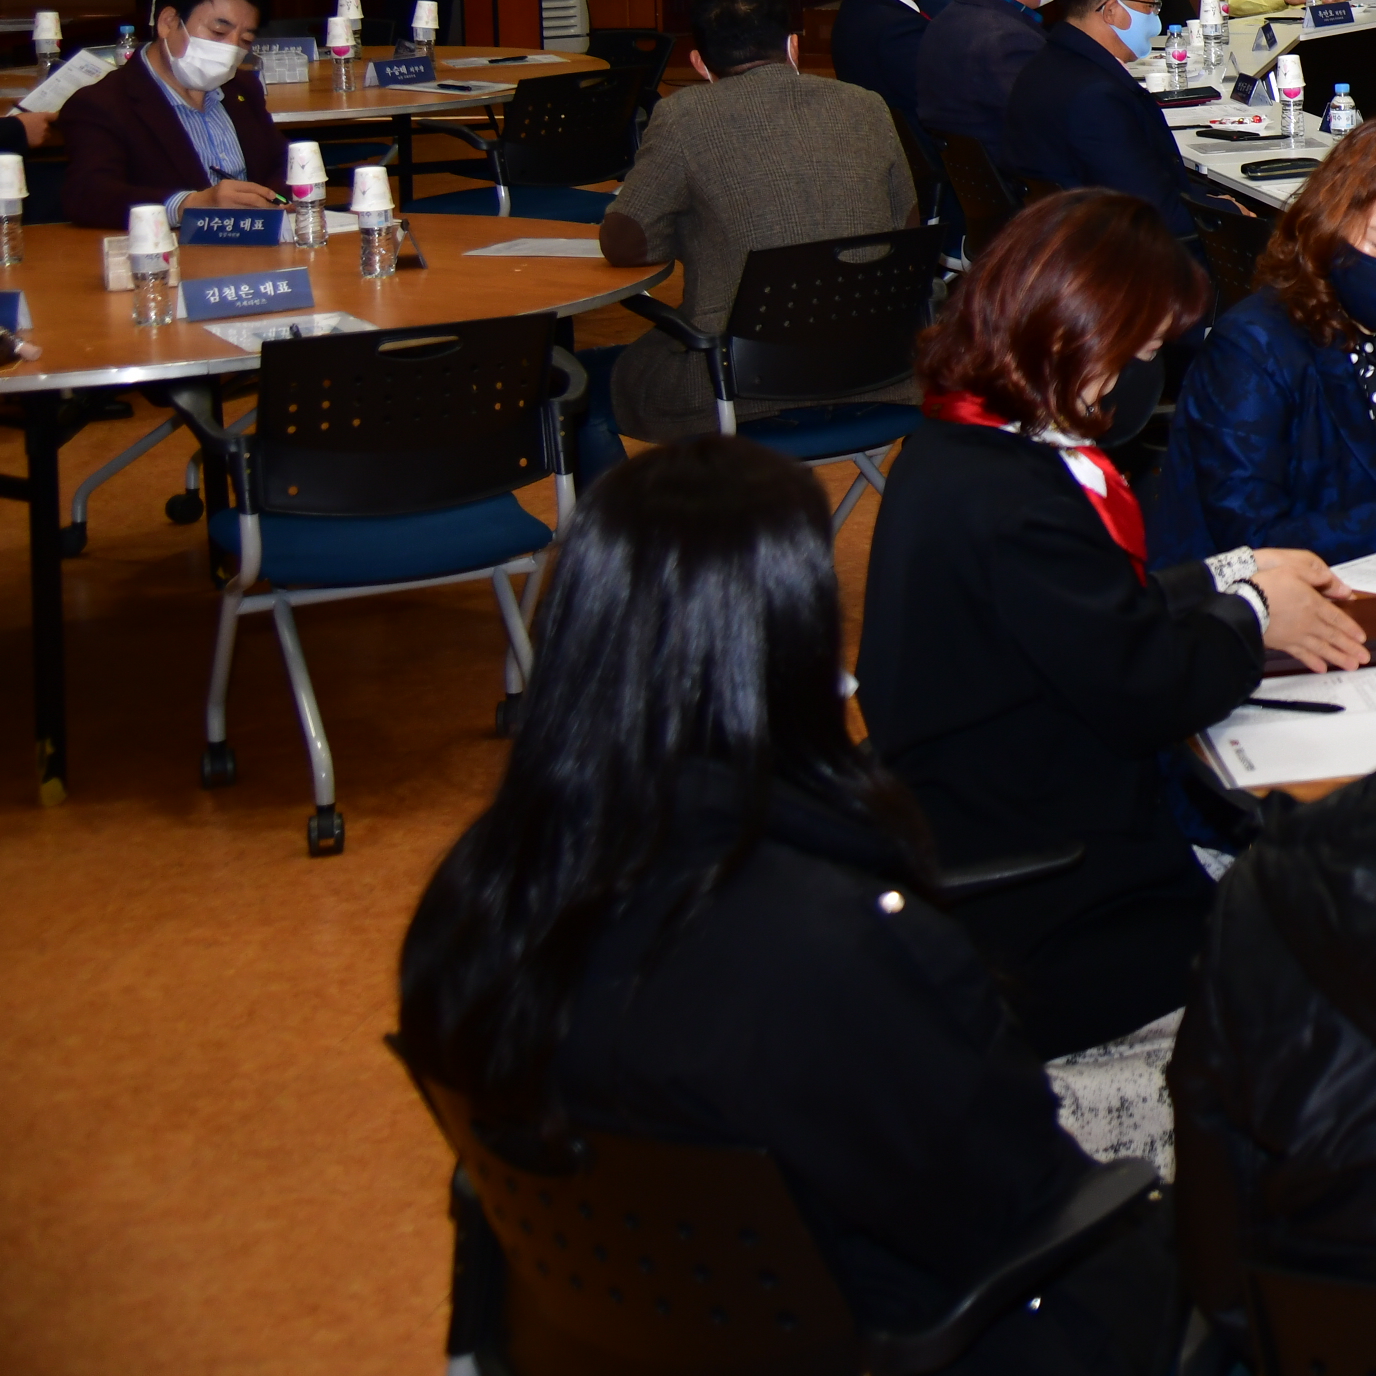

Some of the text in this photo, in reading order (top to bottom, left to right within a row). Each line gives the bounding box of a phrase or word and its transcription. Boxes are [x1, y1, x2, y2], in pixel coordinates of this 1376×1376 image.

[197, 217, 265, 231] 이수영 대표
[206, 280, 292, 303] 김철은 대표
